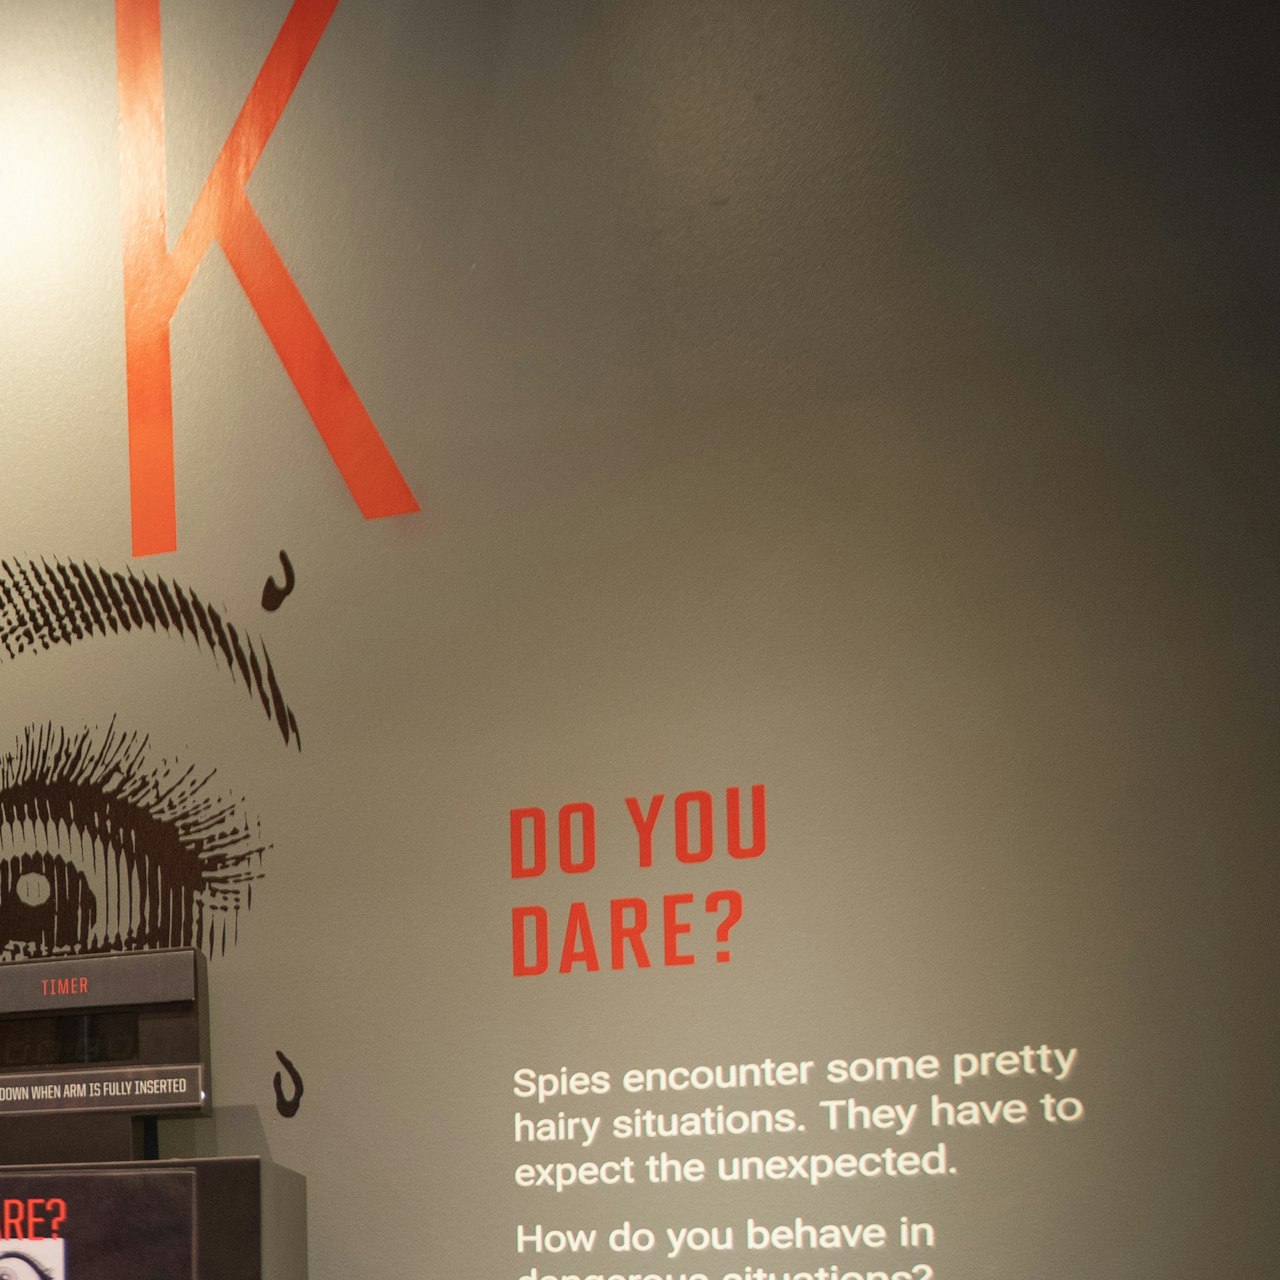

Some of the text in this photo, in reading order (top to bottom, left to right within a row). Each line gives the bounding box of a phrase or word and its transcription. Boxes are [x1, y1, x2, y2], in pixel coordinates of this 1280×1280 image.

[510, 784, 766, 878] DO YOU
[511, 890, 743, 977] DARE?
[41, 978, 88, 996] TIMER
[0, 1086, 29, 1101] DOWN
[31, 1085, 62, 1099] WHEN
[63, 1083, 86, 1098] ARM
[89, 1082, 101, 1097] IS
[103, 1080, 132, 1096] FULLY
[135, 1078, 186, 1094] INSERTED
[513, 1043, 1078, 1103] Spies encounter some pretty
[514, 1093, 1084, 1147] hairy situations. They have to
[515, 1144, 957, 1192] expect the unexpected.
[517, 1217, 935, 1258] How do you behave in
